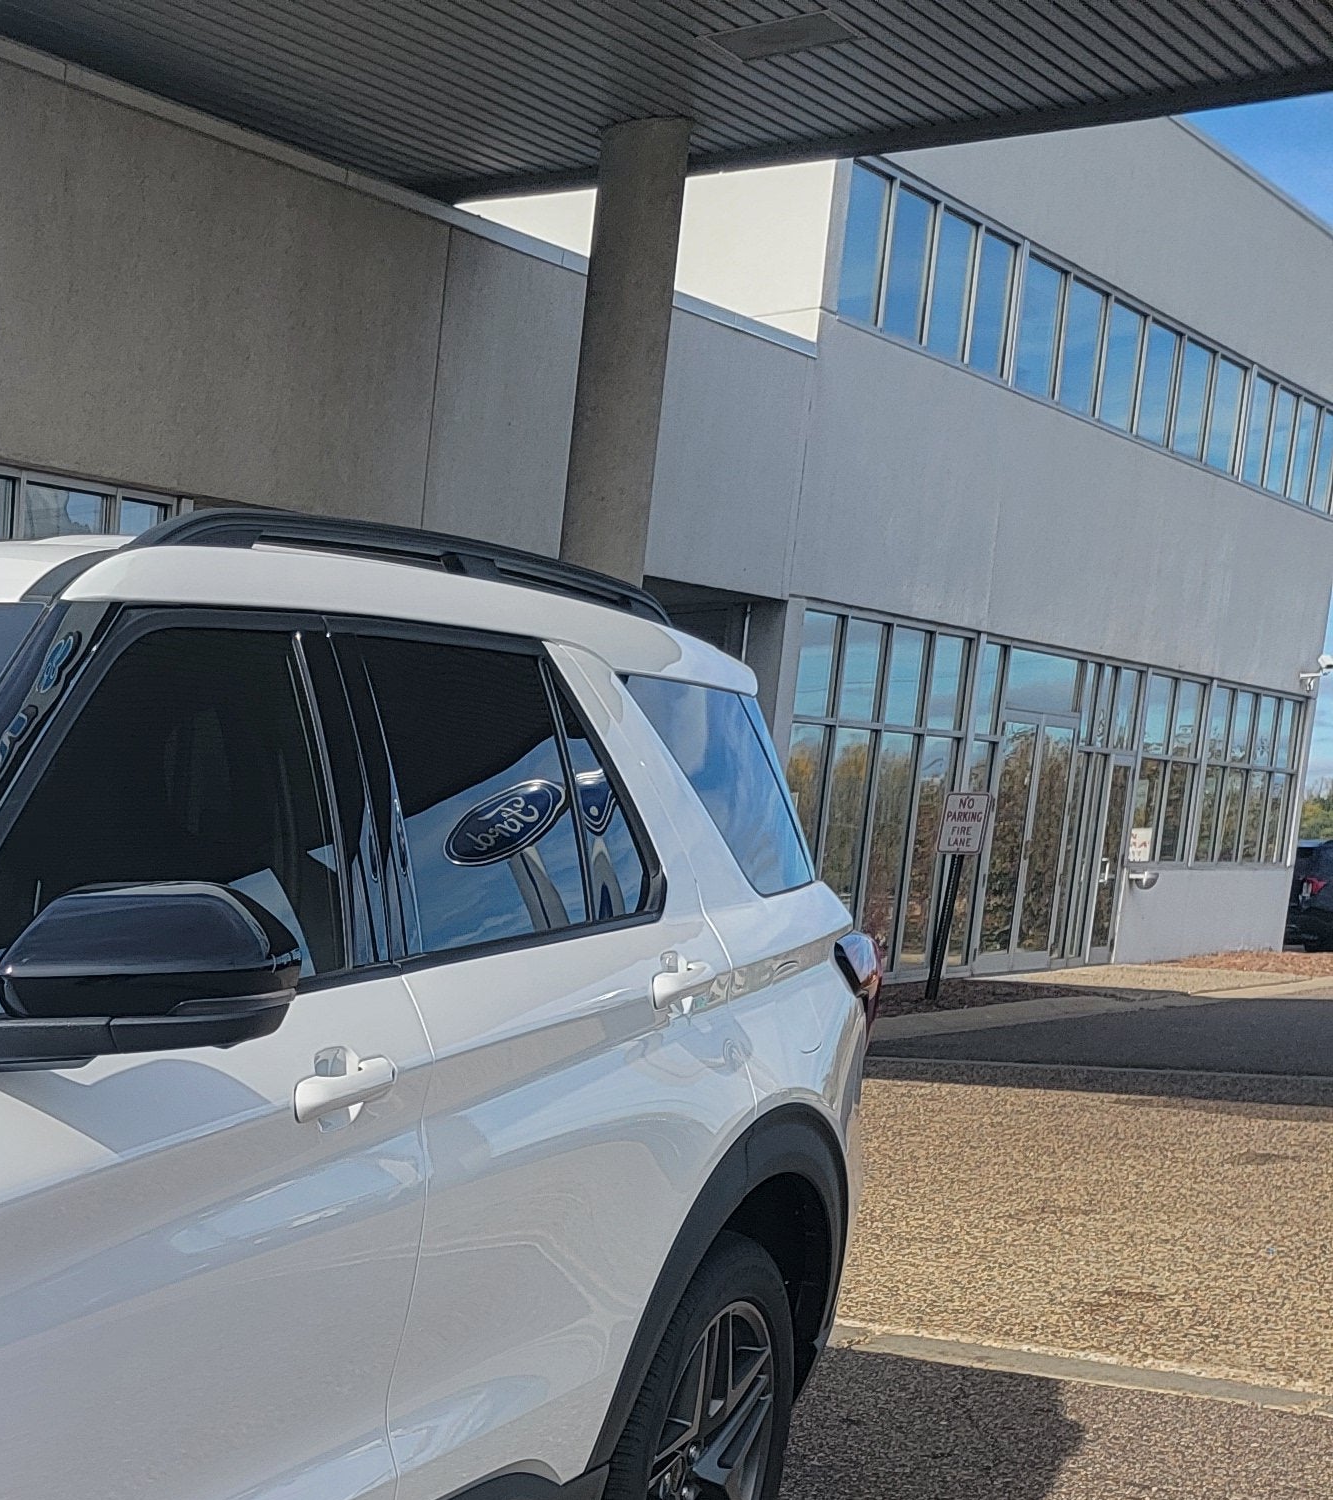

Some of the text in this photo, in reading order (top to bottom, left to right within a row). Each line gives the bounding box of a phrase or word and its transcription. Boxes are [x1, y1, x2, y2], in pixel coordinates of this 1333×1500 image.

[958, 797, 975, 810] NO
[945, 811, 983, 823] PARKING
[951, 826, 973, 836] FIRE
[947, 837, 972, 848] LANE
